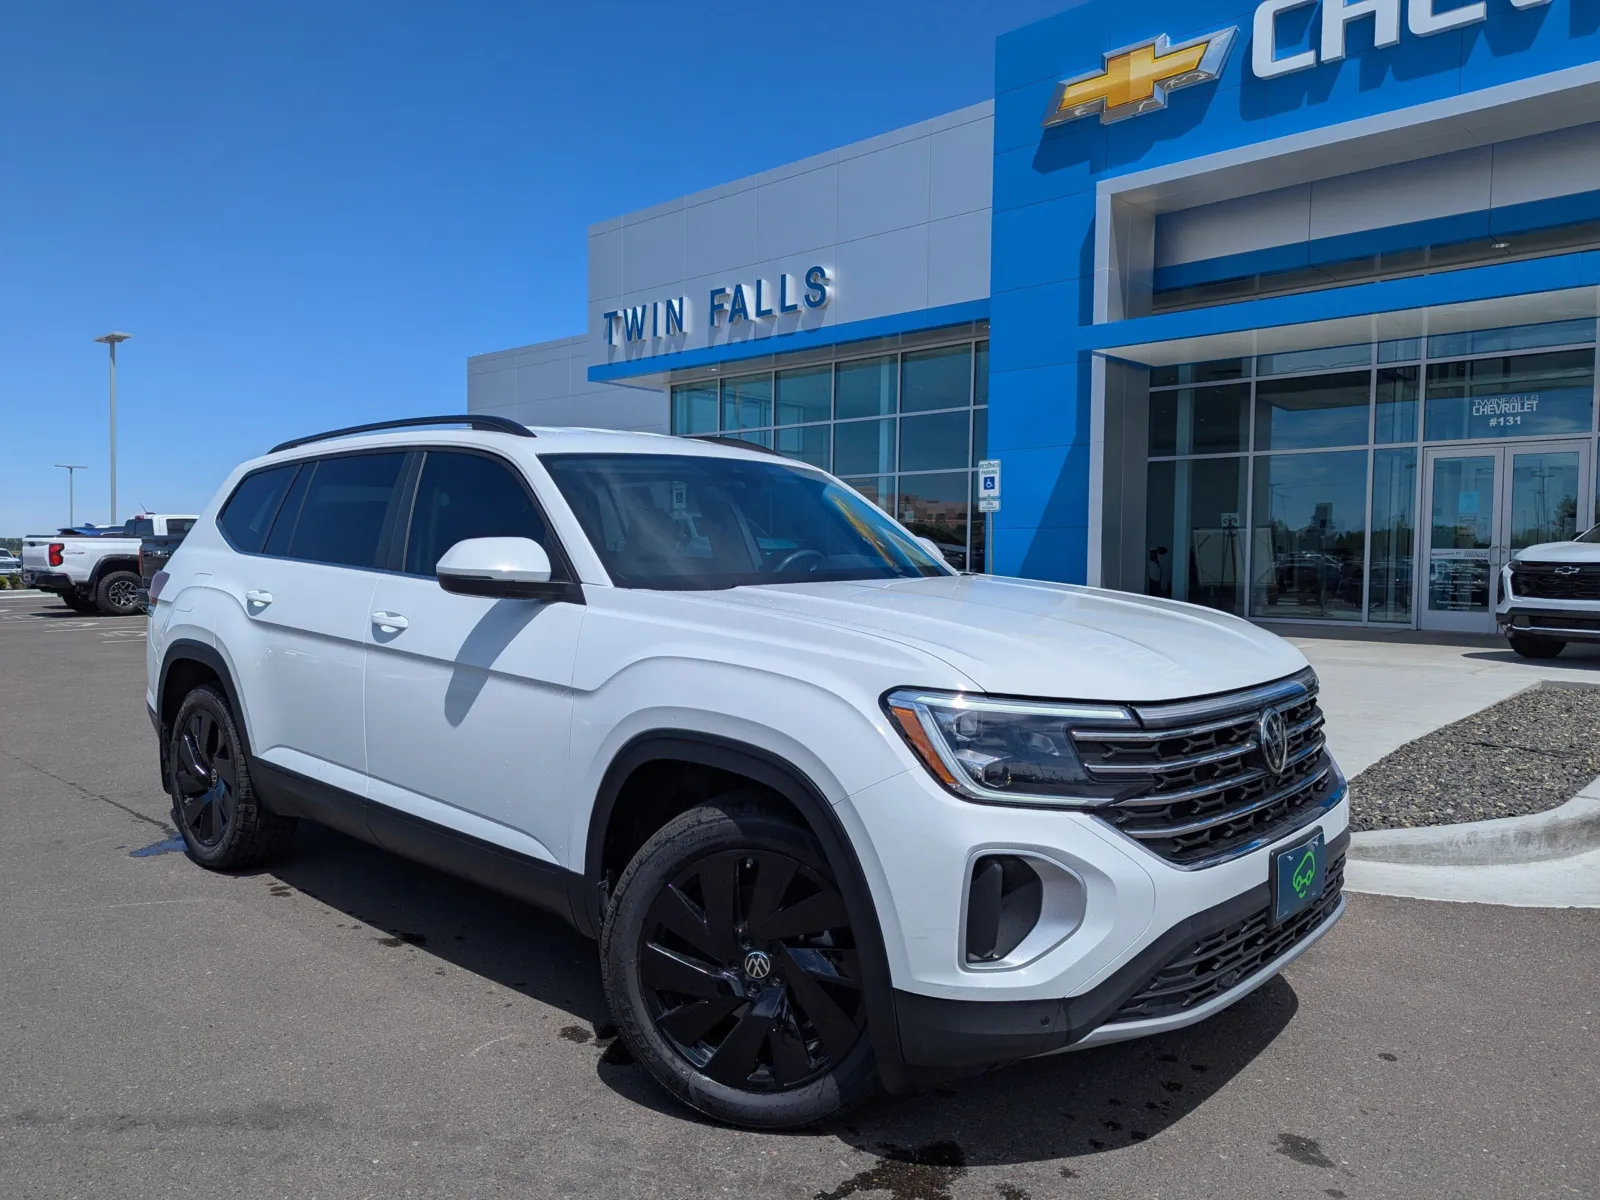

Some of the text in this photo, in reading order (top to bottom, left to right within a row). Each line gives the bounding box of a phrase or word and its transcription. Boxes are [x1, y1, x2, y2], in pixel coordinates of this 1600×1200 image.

[1252, 0, 1552, 80] CH
[603, 265, 831, 346] TWIN FALLS
[1472, 402, 1537, 416] CHEVROLET
[1489, 416, 1521, 426] #131
